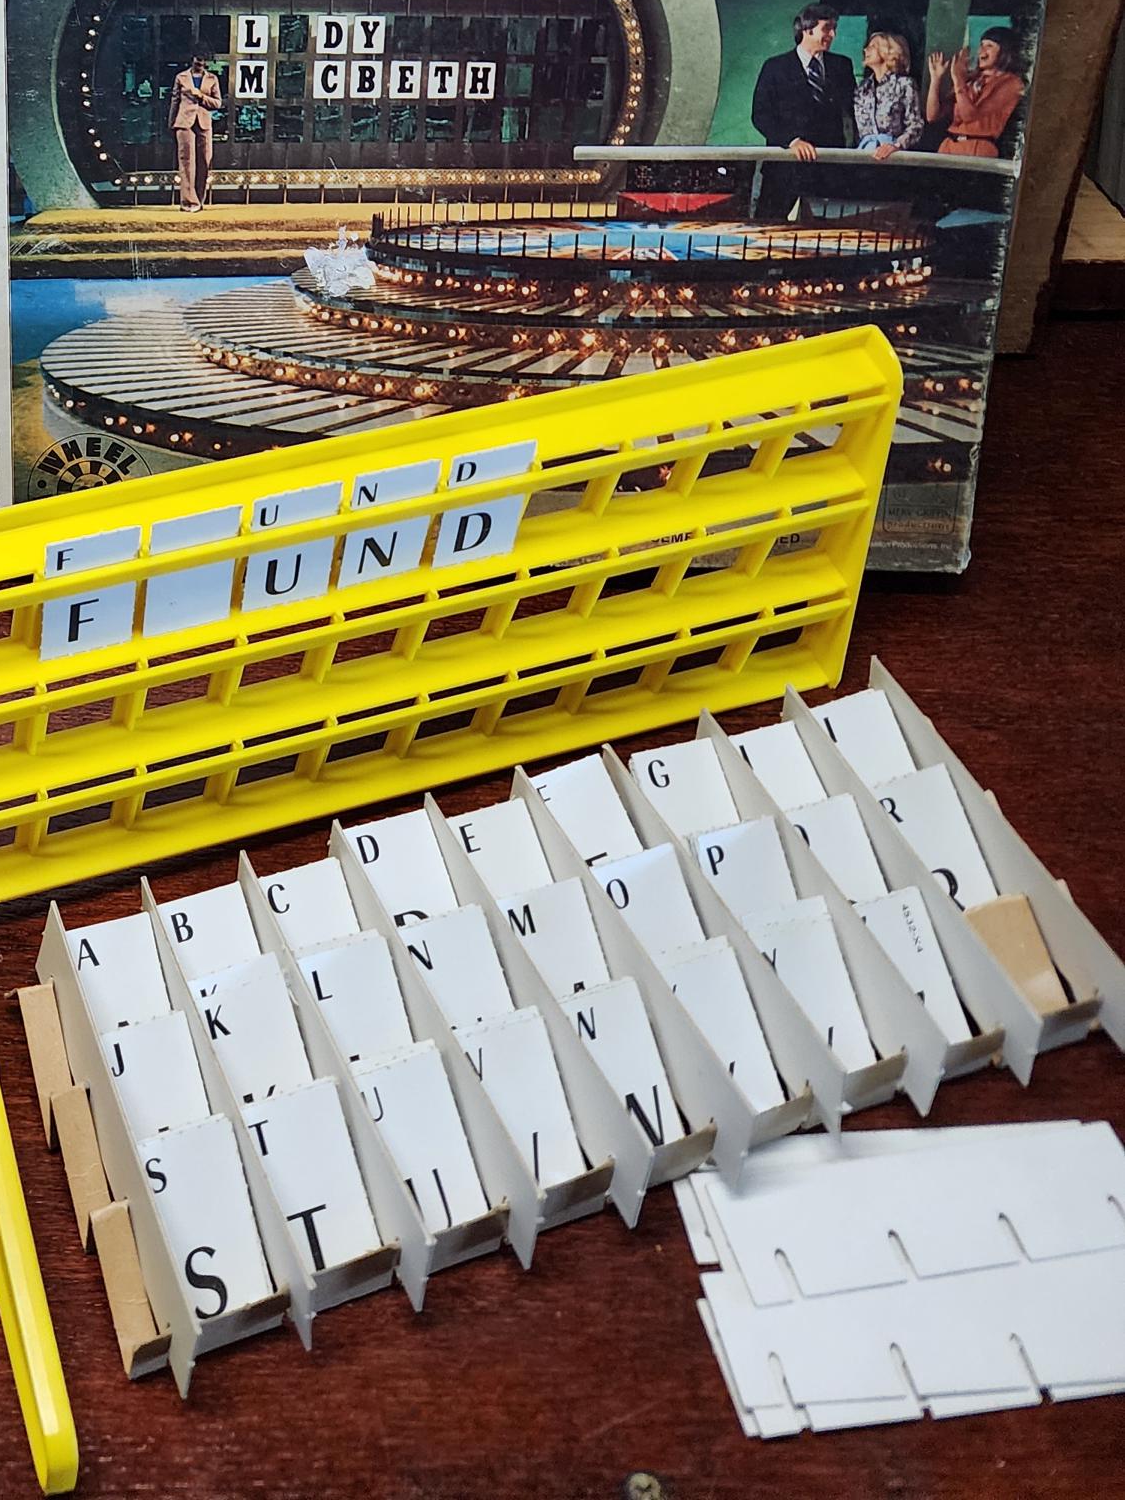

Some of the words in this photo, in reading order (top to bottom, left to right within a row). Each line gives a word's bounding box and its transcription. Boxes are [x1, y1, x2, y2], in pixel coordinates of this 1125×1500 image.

[37, 437, 137, 475] WHEEL
[67, 599, 100, 643] F
[171, 911, 194, 943] B
[77, 938, 99, 971] A
[185, 1245, 228, 1319] S
